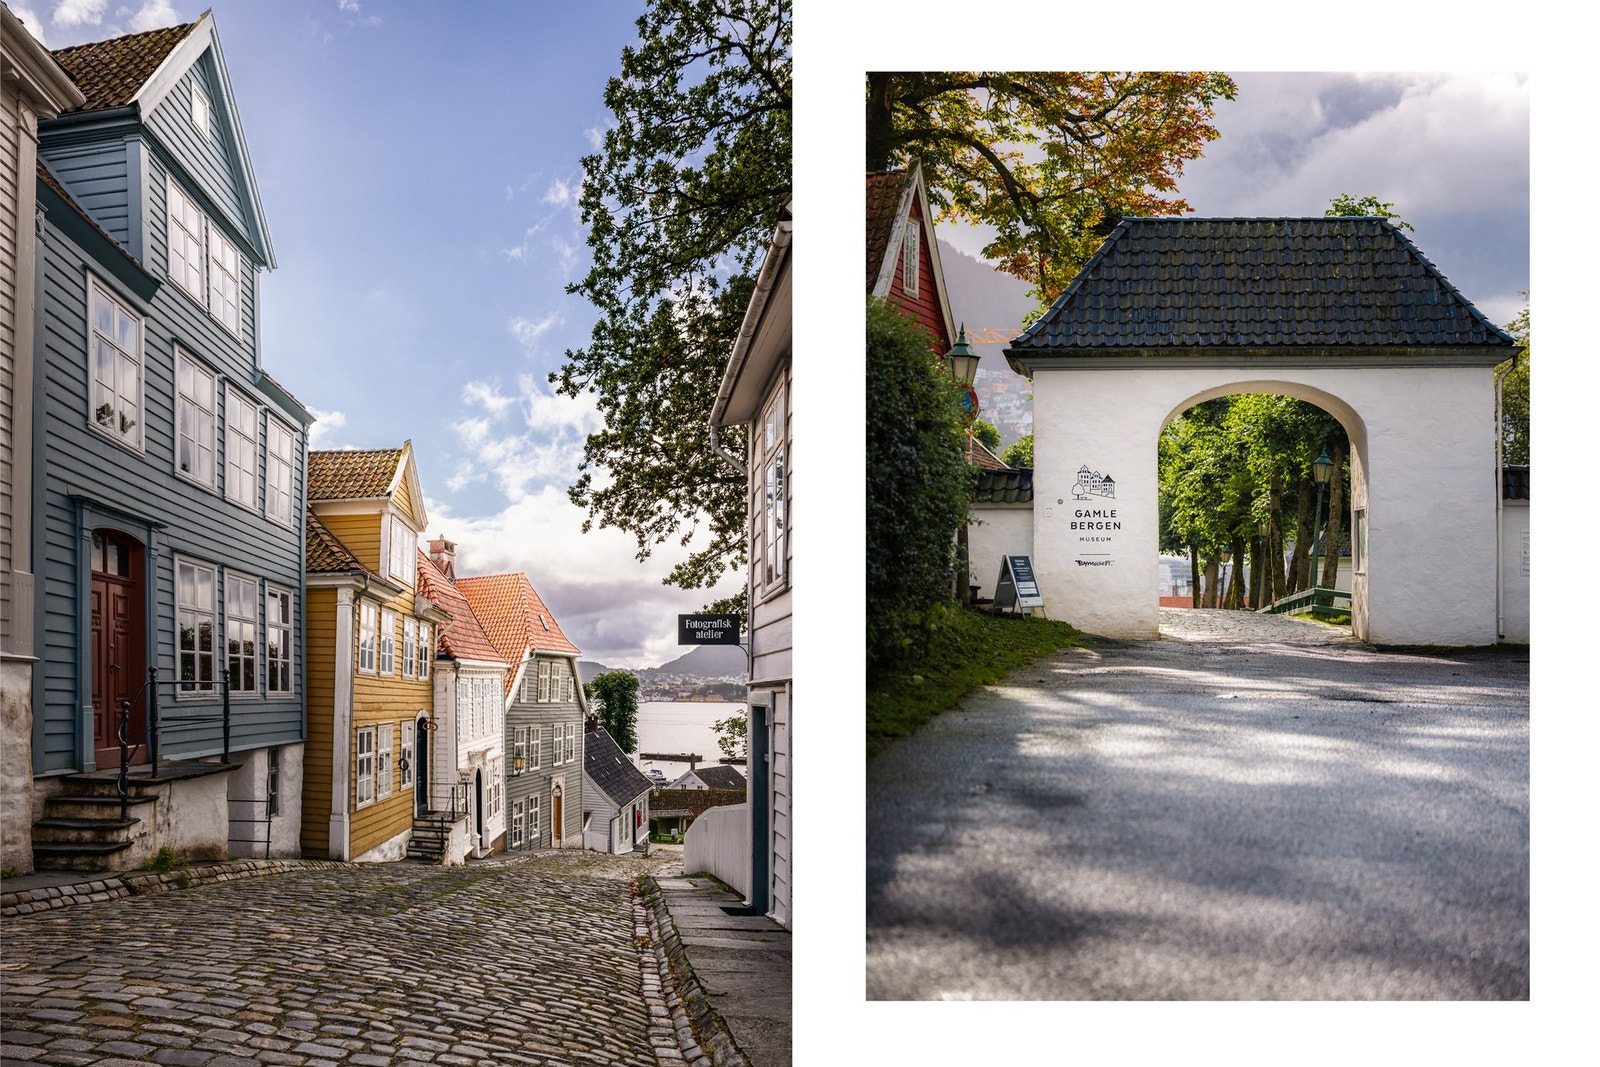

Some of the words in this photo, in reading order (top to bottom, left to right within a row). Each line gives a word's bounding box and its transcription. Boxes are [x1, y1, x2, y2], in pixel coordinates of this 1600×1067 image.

[1074, 509, 1117, 518] GAMLE
[1070, 521, 1121, 530] BERGEN
[685, 619, 732, 630] Fotografisk
[695, 630, 724, 639] atelier
